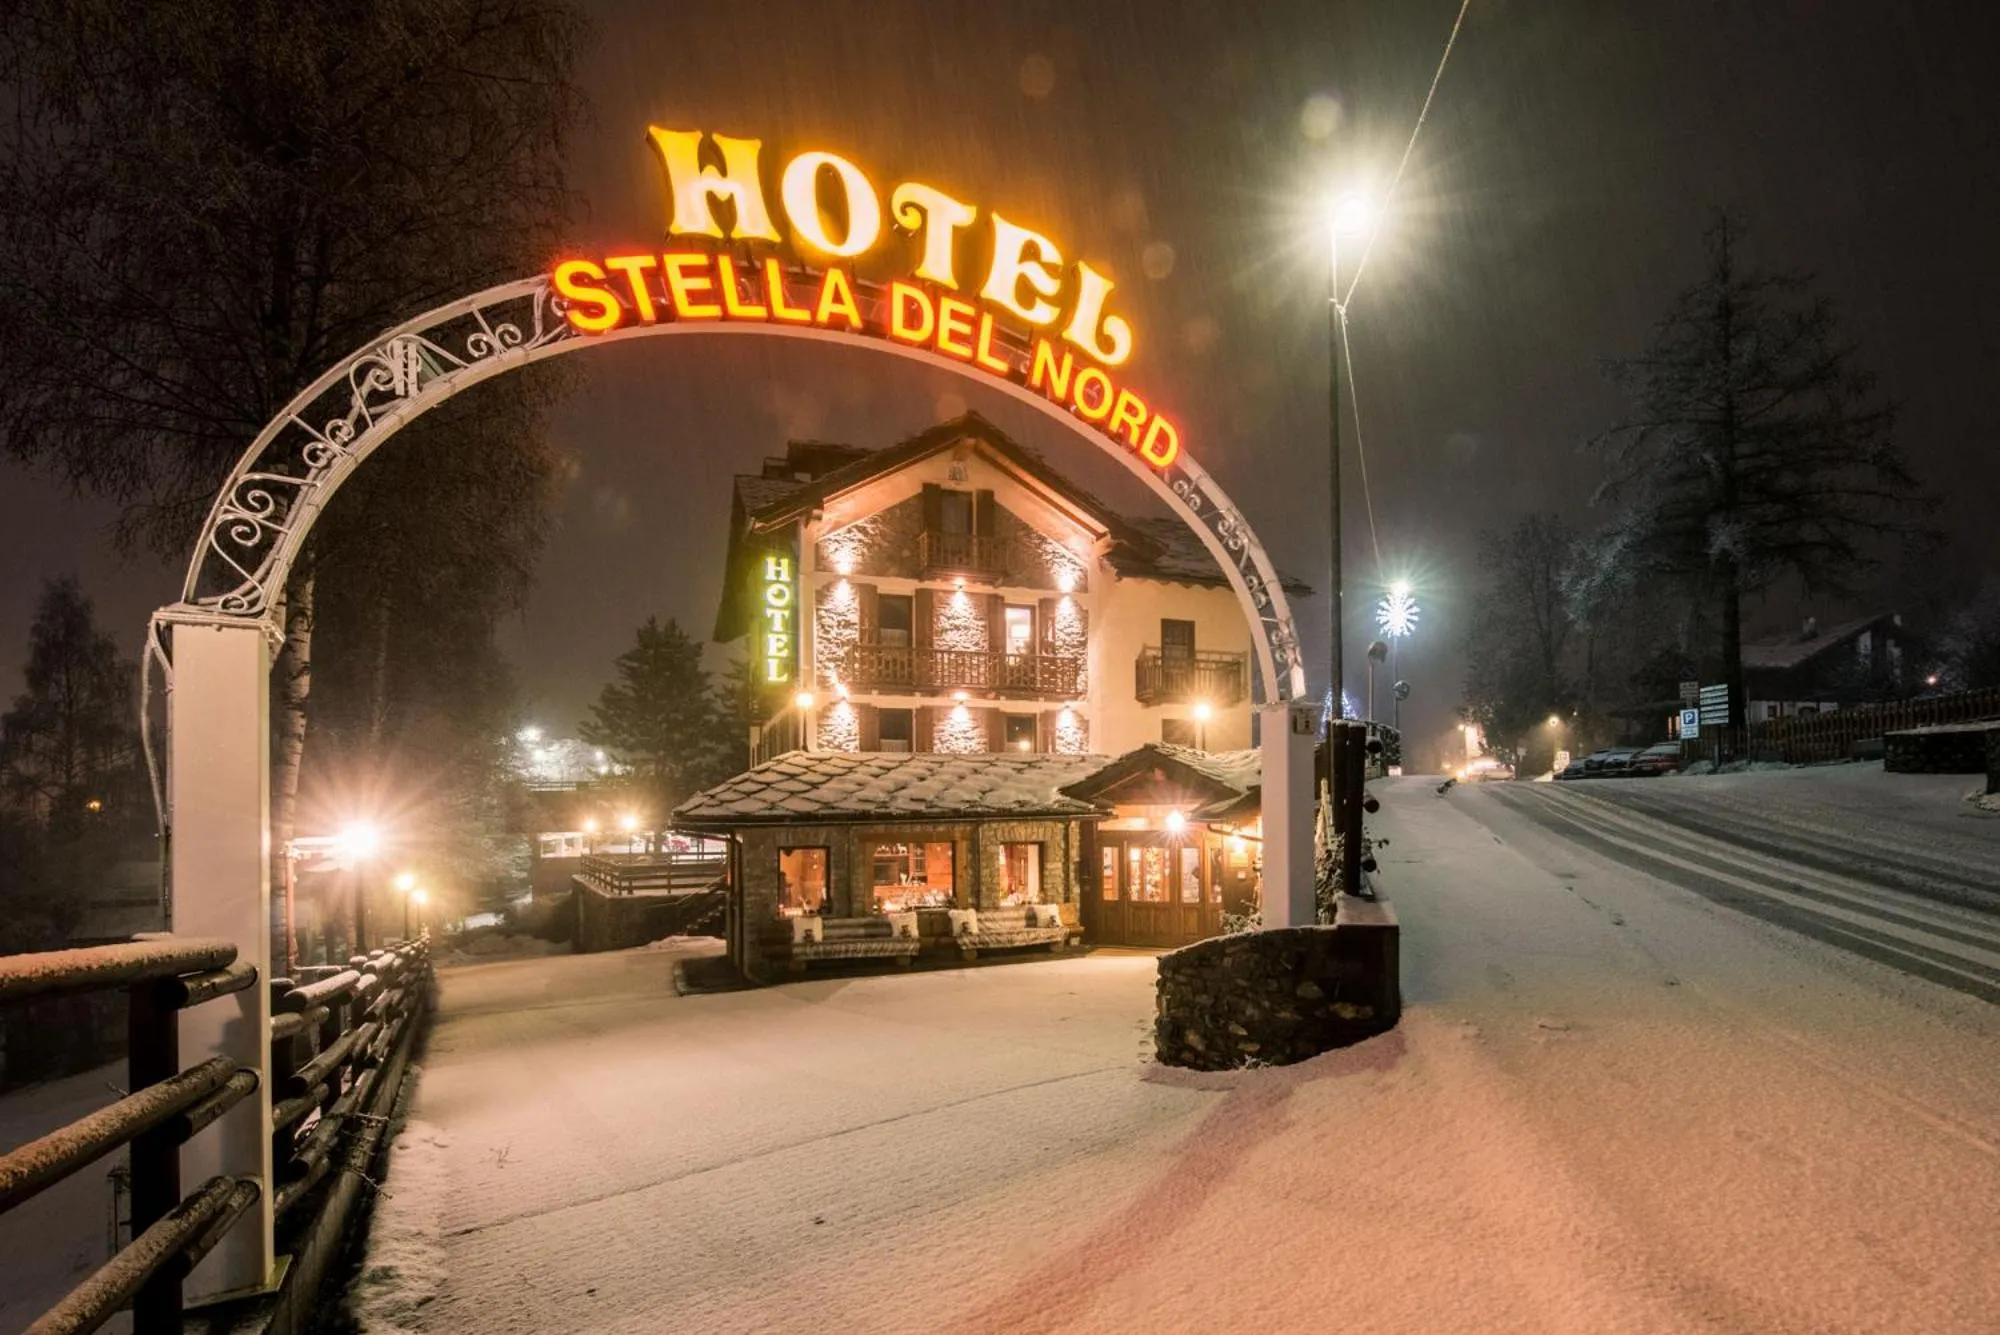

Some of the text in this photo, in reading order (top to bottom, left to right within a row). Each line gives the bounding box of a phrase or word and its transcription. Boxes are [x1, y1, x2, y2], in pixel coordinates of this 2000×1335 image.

[647, 125, 1132, 366] HOTEL
[553, 252, 1180, 469] STELLA DEL NORD
[765, 556, 791, 682] HOTEL
[1685, 713, 1694, 724] P
